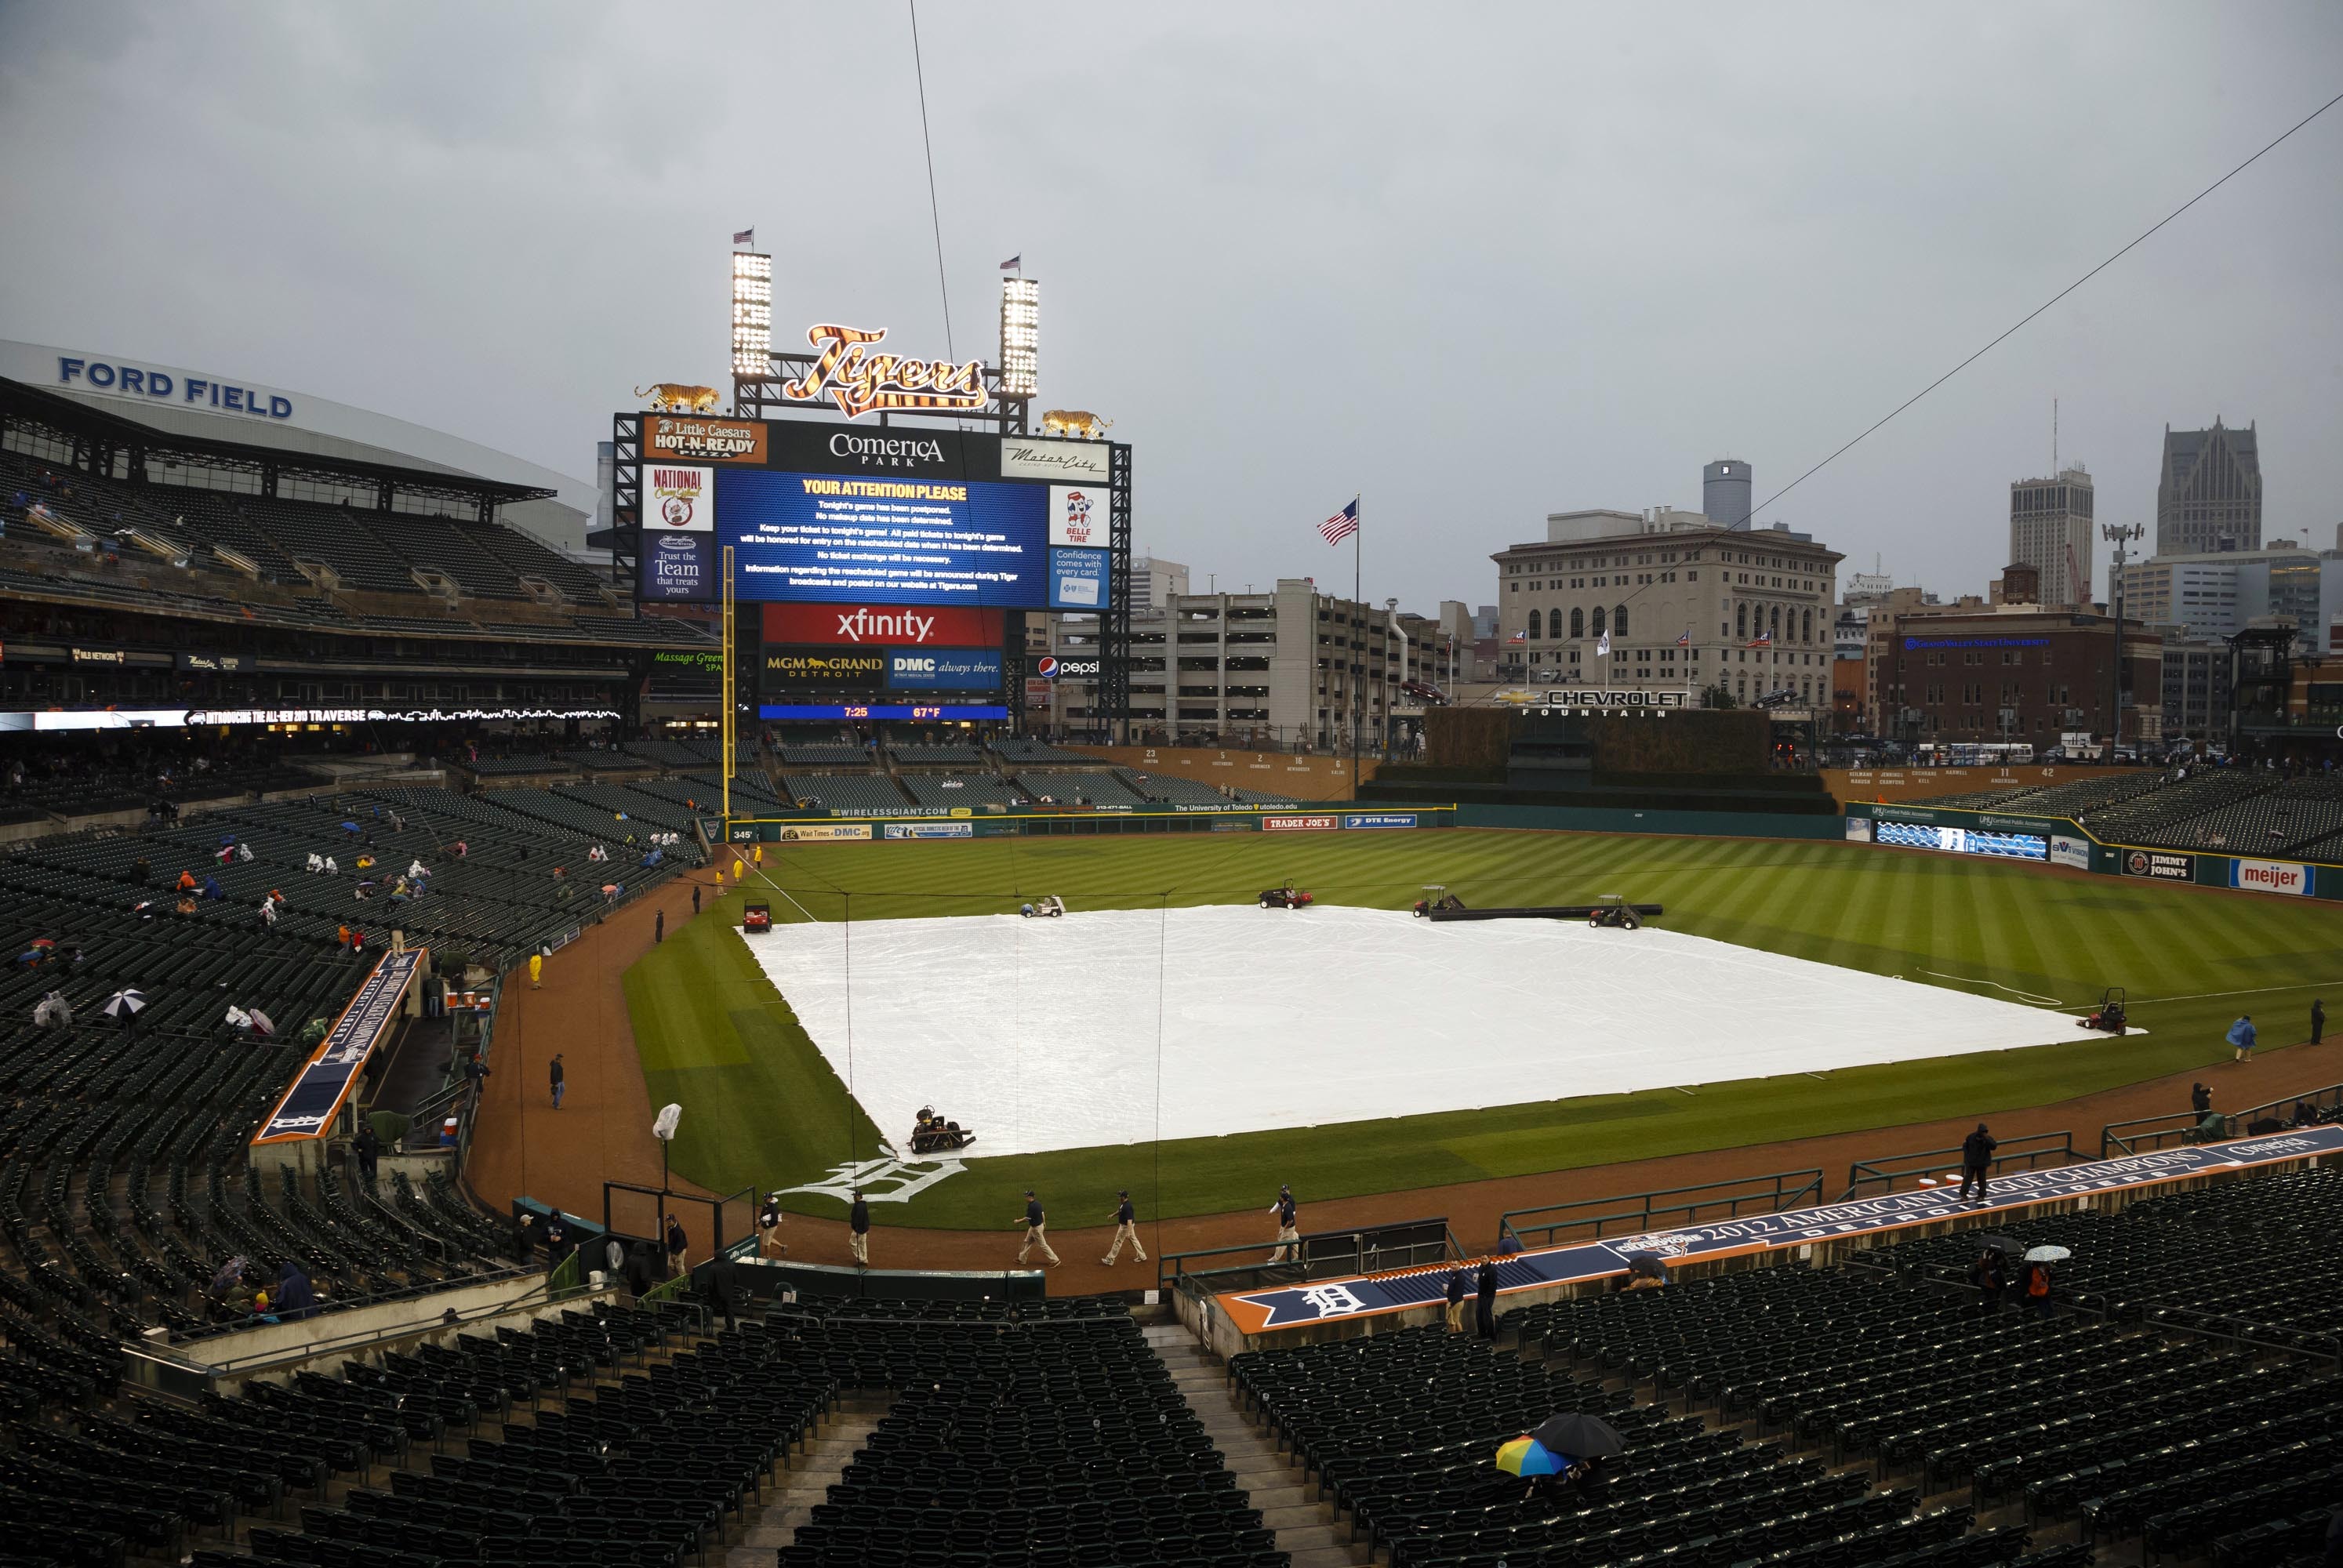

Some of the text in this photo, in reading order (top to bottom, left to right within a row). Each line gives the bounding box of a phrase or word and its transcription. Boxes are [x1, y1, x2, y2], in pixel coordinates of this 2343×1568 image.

[784, 323, 988, 421] Tigers
[57, 356, 292, 419] FORD FIELD
[675, 422, 751, 438] Little Caesars
[655, 434, 756, 452] HOT-N-READY
[861, 456, 915, 466] PARK
[654, 469, 702, 489] NATIONAL
[803, 479, 968, 501] YOUR ATTENTION PLEASE
[818, 501, 854, 511] Tonight's
[876, 503, 891, 512] has
[891, 504, 910, 513] been
[910, 506, 952, 514] postponed.
[828, 513, 858, 523] makeup
[859, 514, 876, 522] date
[876, 514, 891, 523] has
[891, 515, 910, 524] been
[910, 516, 954, 525] determined.
[760, 524, 780, 533] Keep
[830, 528, 864, 536] tonight's
[902, 530, 919, 539] paid
[919, 530, 944, 539] tickets
[954, 532, 985, 541] tonight's
[985, 534, 1006, 543] game
[766, 535, 799, 544] honored
[812, 537, 832, 547] entry
[903, 540, 921, 549] date
[921, 542, 942, 550] when
[981, 544, 1023, 553] determined.
[659, 551, 696, 561] Trust the
[852, 553, 888, 562] exchange
[912, 556, 952, 564] necessary.
[1056, 550, 1102, 560] Confidence
[655, 560, 699, 576] Team
[1084, 560, 1102, 568] with
[745, 564, 790, 573] Information
[790, 566, 828, 576] regarding
[934, 572, 975, 580] announced
[975, 572, 999, 582] during
[1000, 572, 1019, 582] Tiger
[1056, 568, 1079, 578] every
[657, 576, 674, 585] that
[789, 577, 832, 586] broadcasts
[937, 582, 978, 590] Tigers.com
[666, 586, 689, 595] yours
[837, 608, 935, 642] xfinity
[80, 651, 93, 659] MLB
[93, 652, 117, 661] NETWORK
[654, 652, 723, 665] Massage Green
[705, 663, 722, 672] SPA
[768, 657, 884, 670] MGM GRAND
[894, 658, 998, 675] DMC always there.
[1061, 660, 1099, 675] pepsi
[1548, 690, 1690, 706] CHEVROLET
[205, 710, 365, 724] INTRODUCING THE ALL-NEW 2013 TRAVERSE
[845, 707, 869, 717] 7:25
[913, 707, 940, 717] 67°F
[1522, 709, 1666, 717] FOUNTAIN
[2001, 768, 2009, 777] 11
[2041, 768, 2054, 777] 42
[841, 808, 948, 817] WIRELESSGIANT.COM
[1270, 818, 1330, 828] TRADER JOE'S
[2151, 855, 2187, 866] JIMMY
[2150, 866, 2188, 877] JOHN'S
[2244, 866, 2298, 887] meijer
[333, 979, 380, 1038] DETROIT TIGERS
[2265, 1146, 2307, 1156] PARK
[1699, 1151, 2203, 1241] 2012 AMERICAN CHAMPIONS
[1802, 1171, 2170, 1237] DETROIT TIGERS
[1615, 1233, 1705, 1253] CHAMPIONS
